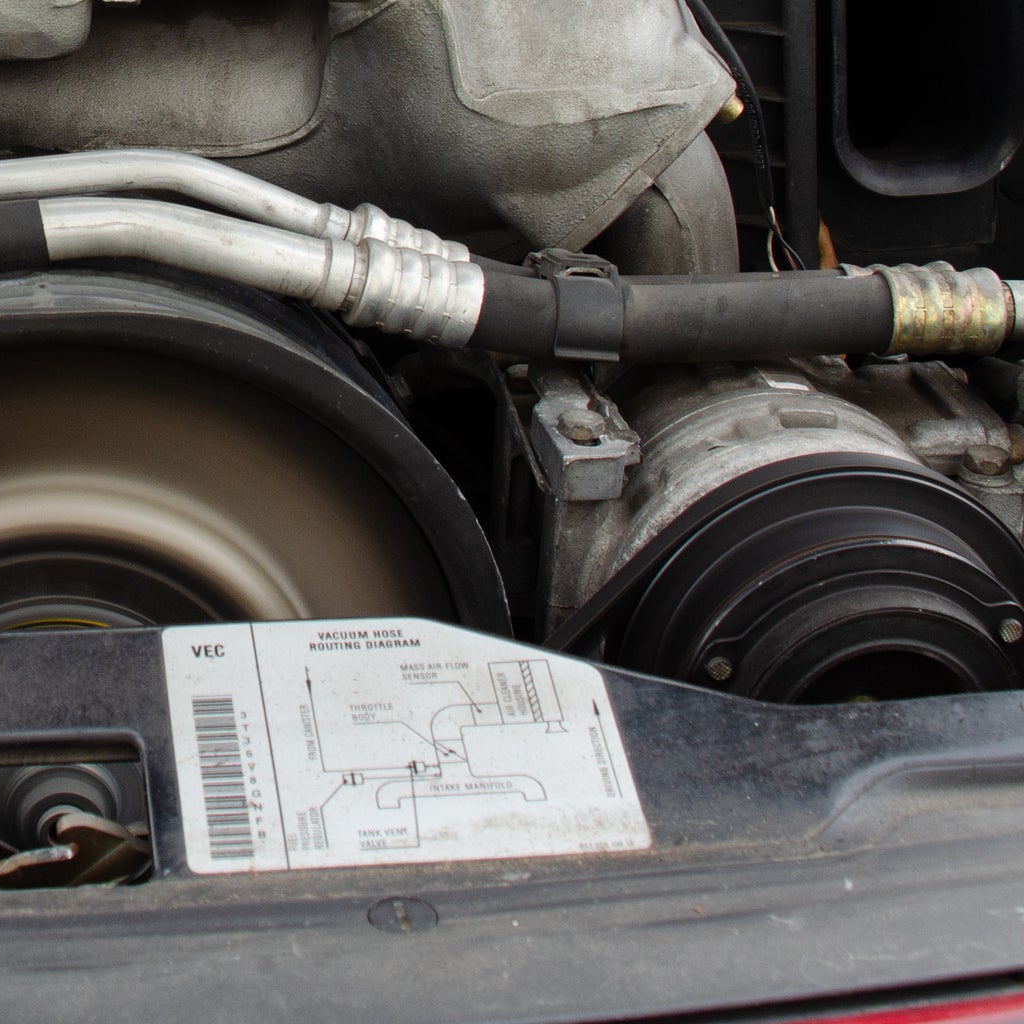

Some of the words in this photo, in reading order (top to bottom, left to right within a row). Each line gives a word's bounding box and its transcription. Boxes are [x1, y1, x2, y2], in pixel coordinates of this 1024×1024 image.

[317, 630, 369, 640] VACUUM
[373, 629, 404, 638] HOSE
[191, 644, 225, 658] VEC
[309, 641, 361, 651] ROUTING
[366, 639, 421, 649] DIAGRAM
[402, 672, 438, 680] SENSOR
[496, 672, 513, 703] CLEANER
[511, 684, 528, 716] HOUSING
[349, 703, 394, 712] THROTTLE
[299, 704, 314, 738] CANISTER
[352, 713, 377, 721] BODY
[307, 740, 318, 761] FROM
[588, 726, 607, 765] DIRECTION
[429, 783, 461, 792] INTAKE
[465, 781, 513, 790] MANIFOLD
[599, 767, 616, 797] DRIVING
[296, 811, 312, 851] PRESSURE
[357, 829, 382, 838] TANK
[359, 840, 387, 848] VALVE
